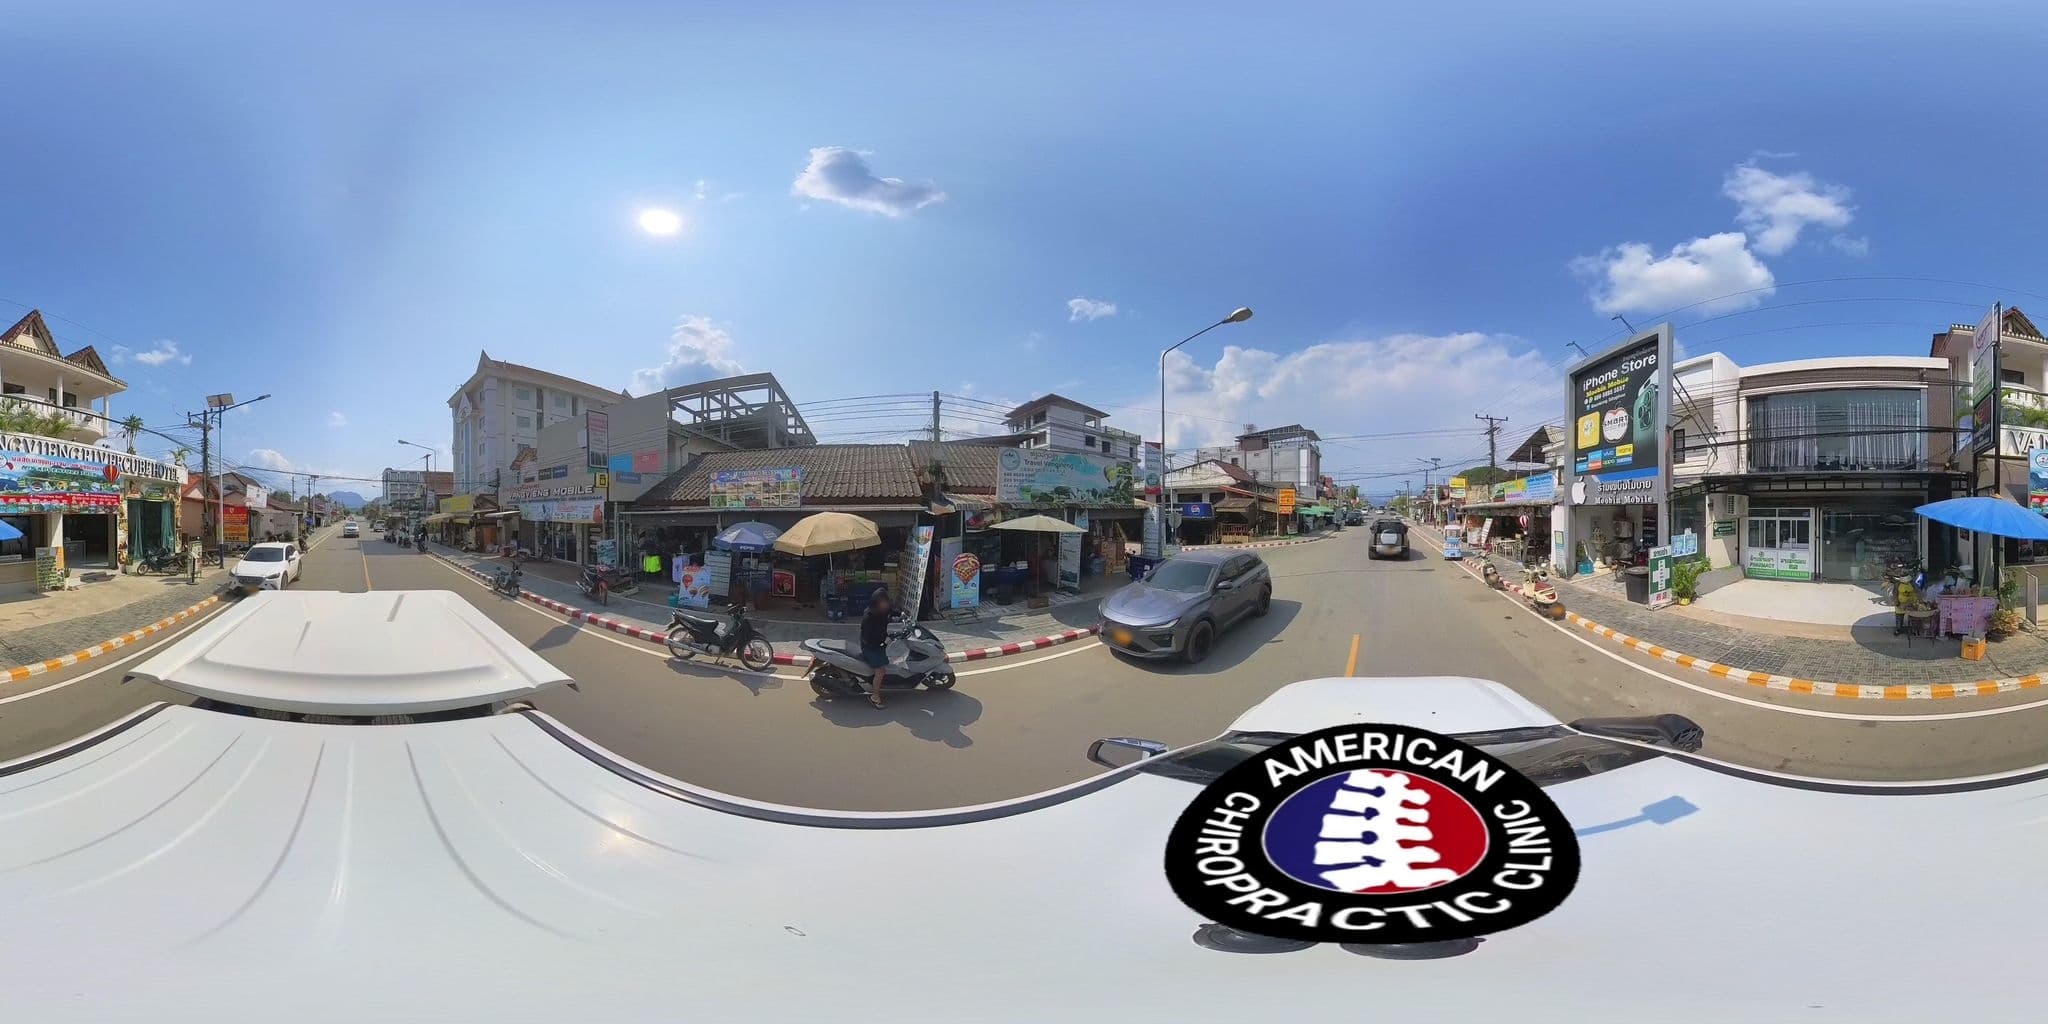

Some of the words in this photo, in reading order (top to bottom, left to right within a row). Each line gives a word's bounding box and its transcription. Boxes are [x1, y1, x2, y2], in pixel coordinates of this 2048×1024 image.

[1583, 369, 1618, 391] iPhone
[1620, 354, 1657, 375] Store
[552, 484, 595, 496] MOBILE
